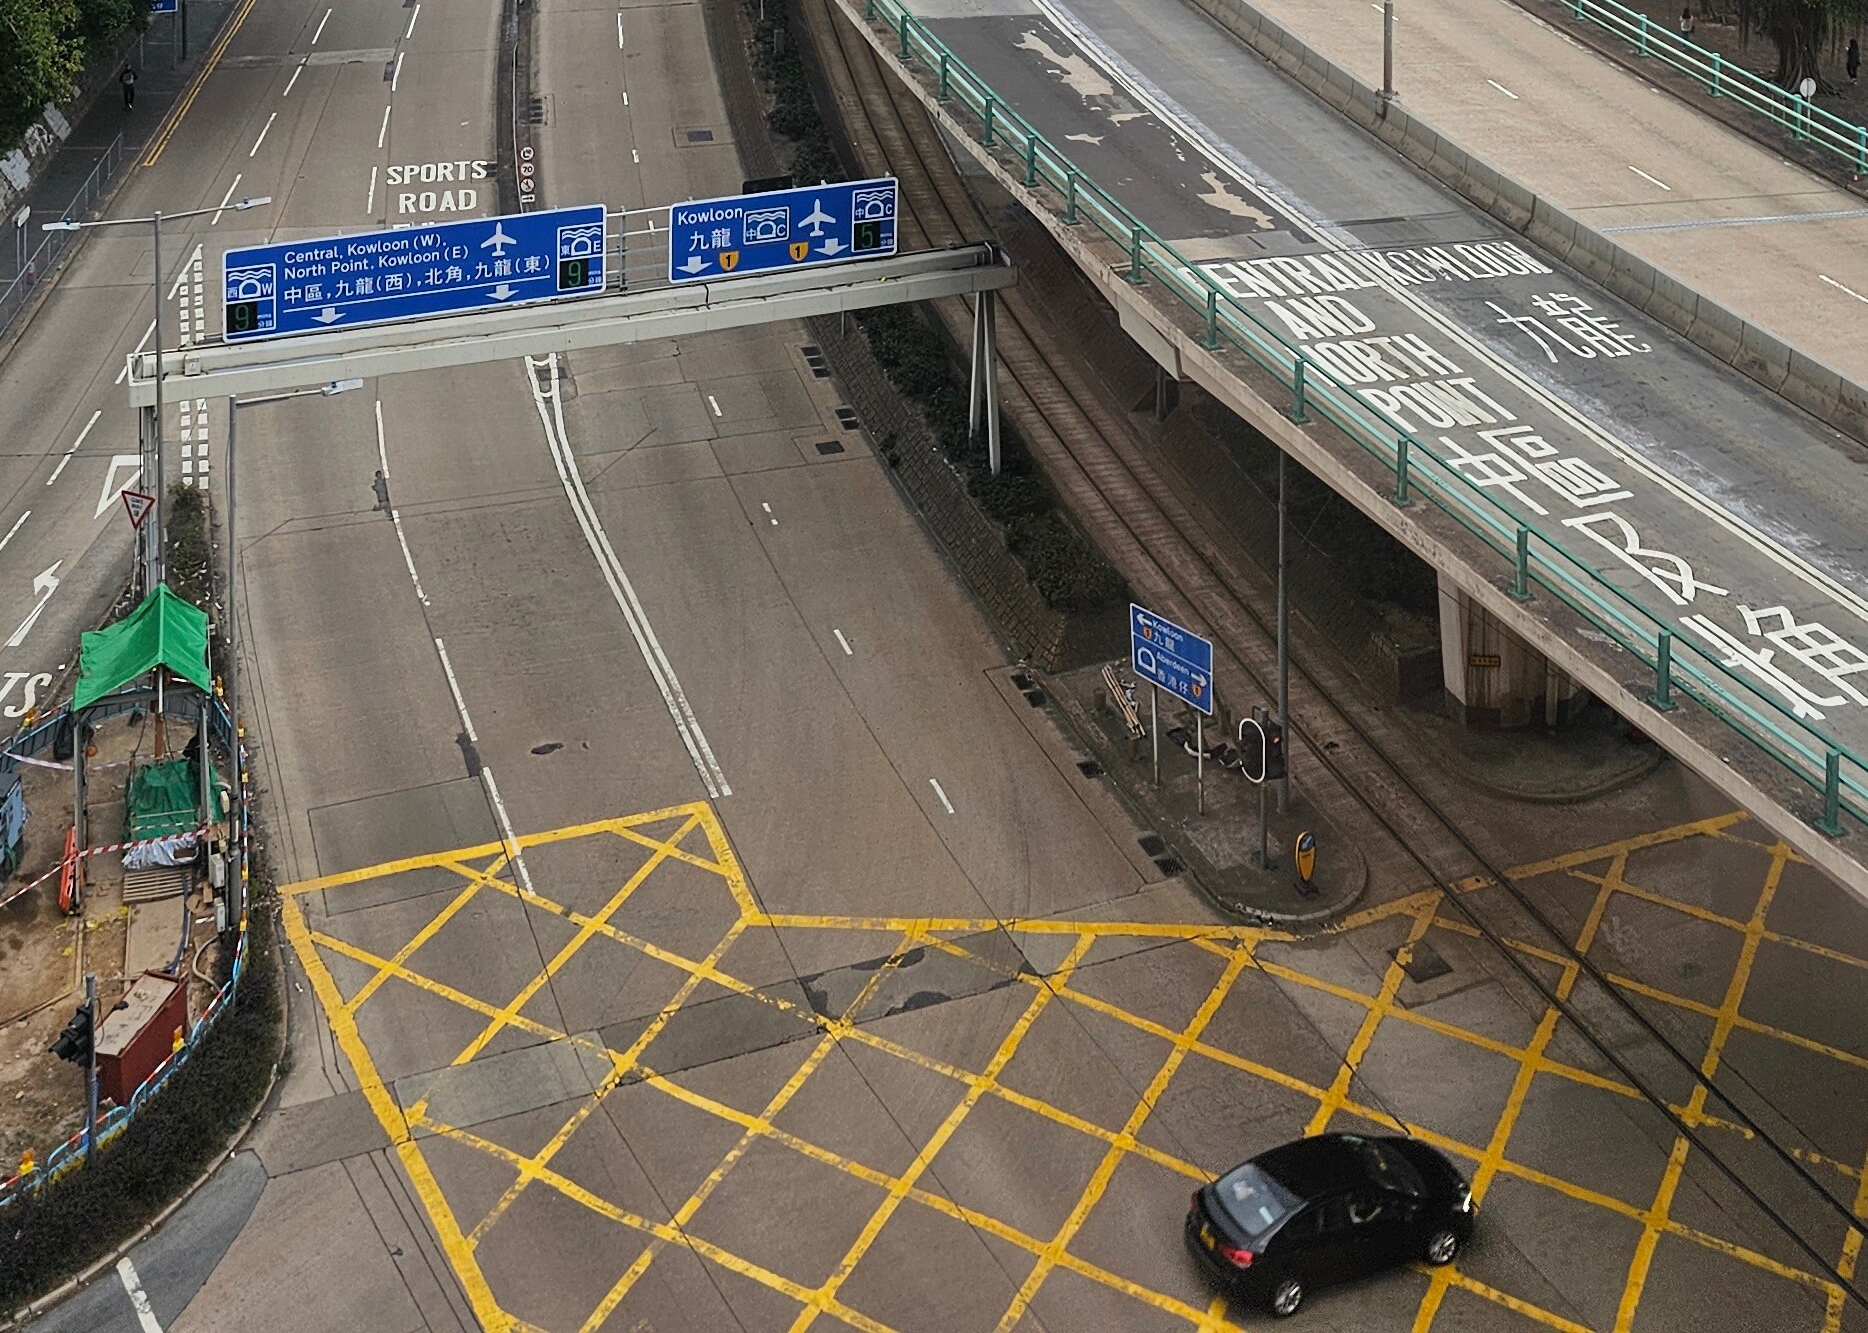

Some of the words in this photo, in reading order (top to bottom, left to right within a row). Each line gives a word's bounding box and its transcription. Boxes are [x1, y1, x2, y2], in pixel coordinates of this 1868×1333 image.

[387, 160, 488, 185] SPORTS
[523, 165, 533, 173] 70
[399, 189, 477, 214] ROAD
[885, 203, 893, 214] C
[678, 207, 743, 226] Kowloon
[689, 228, 731, 251] 九龍
[776, 224, 786, 236] C
[862, 224, 873, 248] 5
[347, 239, 409, 257] Kowloon
[593, 240, 602, 252] E
[284, 263, 326, 281] North
[379, 251, 440, 269] Kowloon
[444, 245, 469, 262] (E)
[569, 261, 581, 286] 9
[1177, 250, 1379, 300] CENTRAL
[1360, 241, 1553, 285] KOWLOON
[262, 282, 273, 295] W
[236, 304, 249, 331] 9
[1264, 295, 1376, 340] AND
[1485, 292, 1652, 363] 九龍
[1286, 333, 1464, 388] NORTH
[1357, 377, 1518, 433] POINT
[1439, 425, 1635, 515] 中區
[1561, 511, 1730, 605] 及
[1152, 619, 1184, 642] Kowloon
[1156, 651, 1189, 675] Aberdeen
